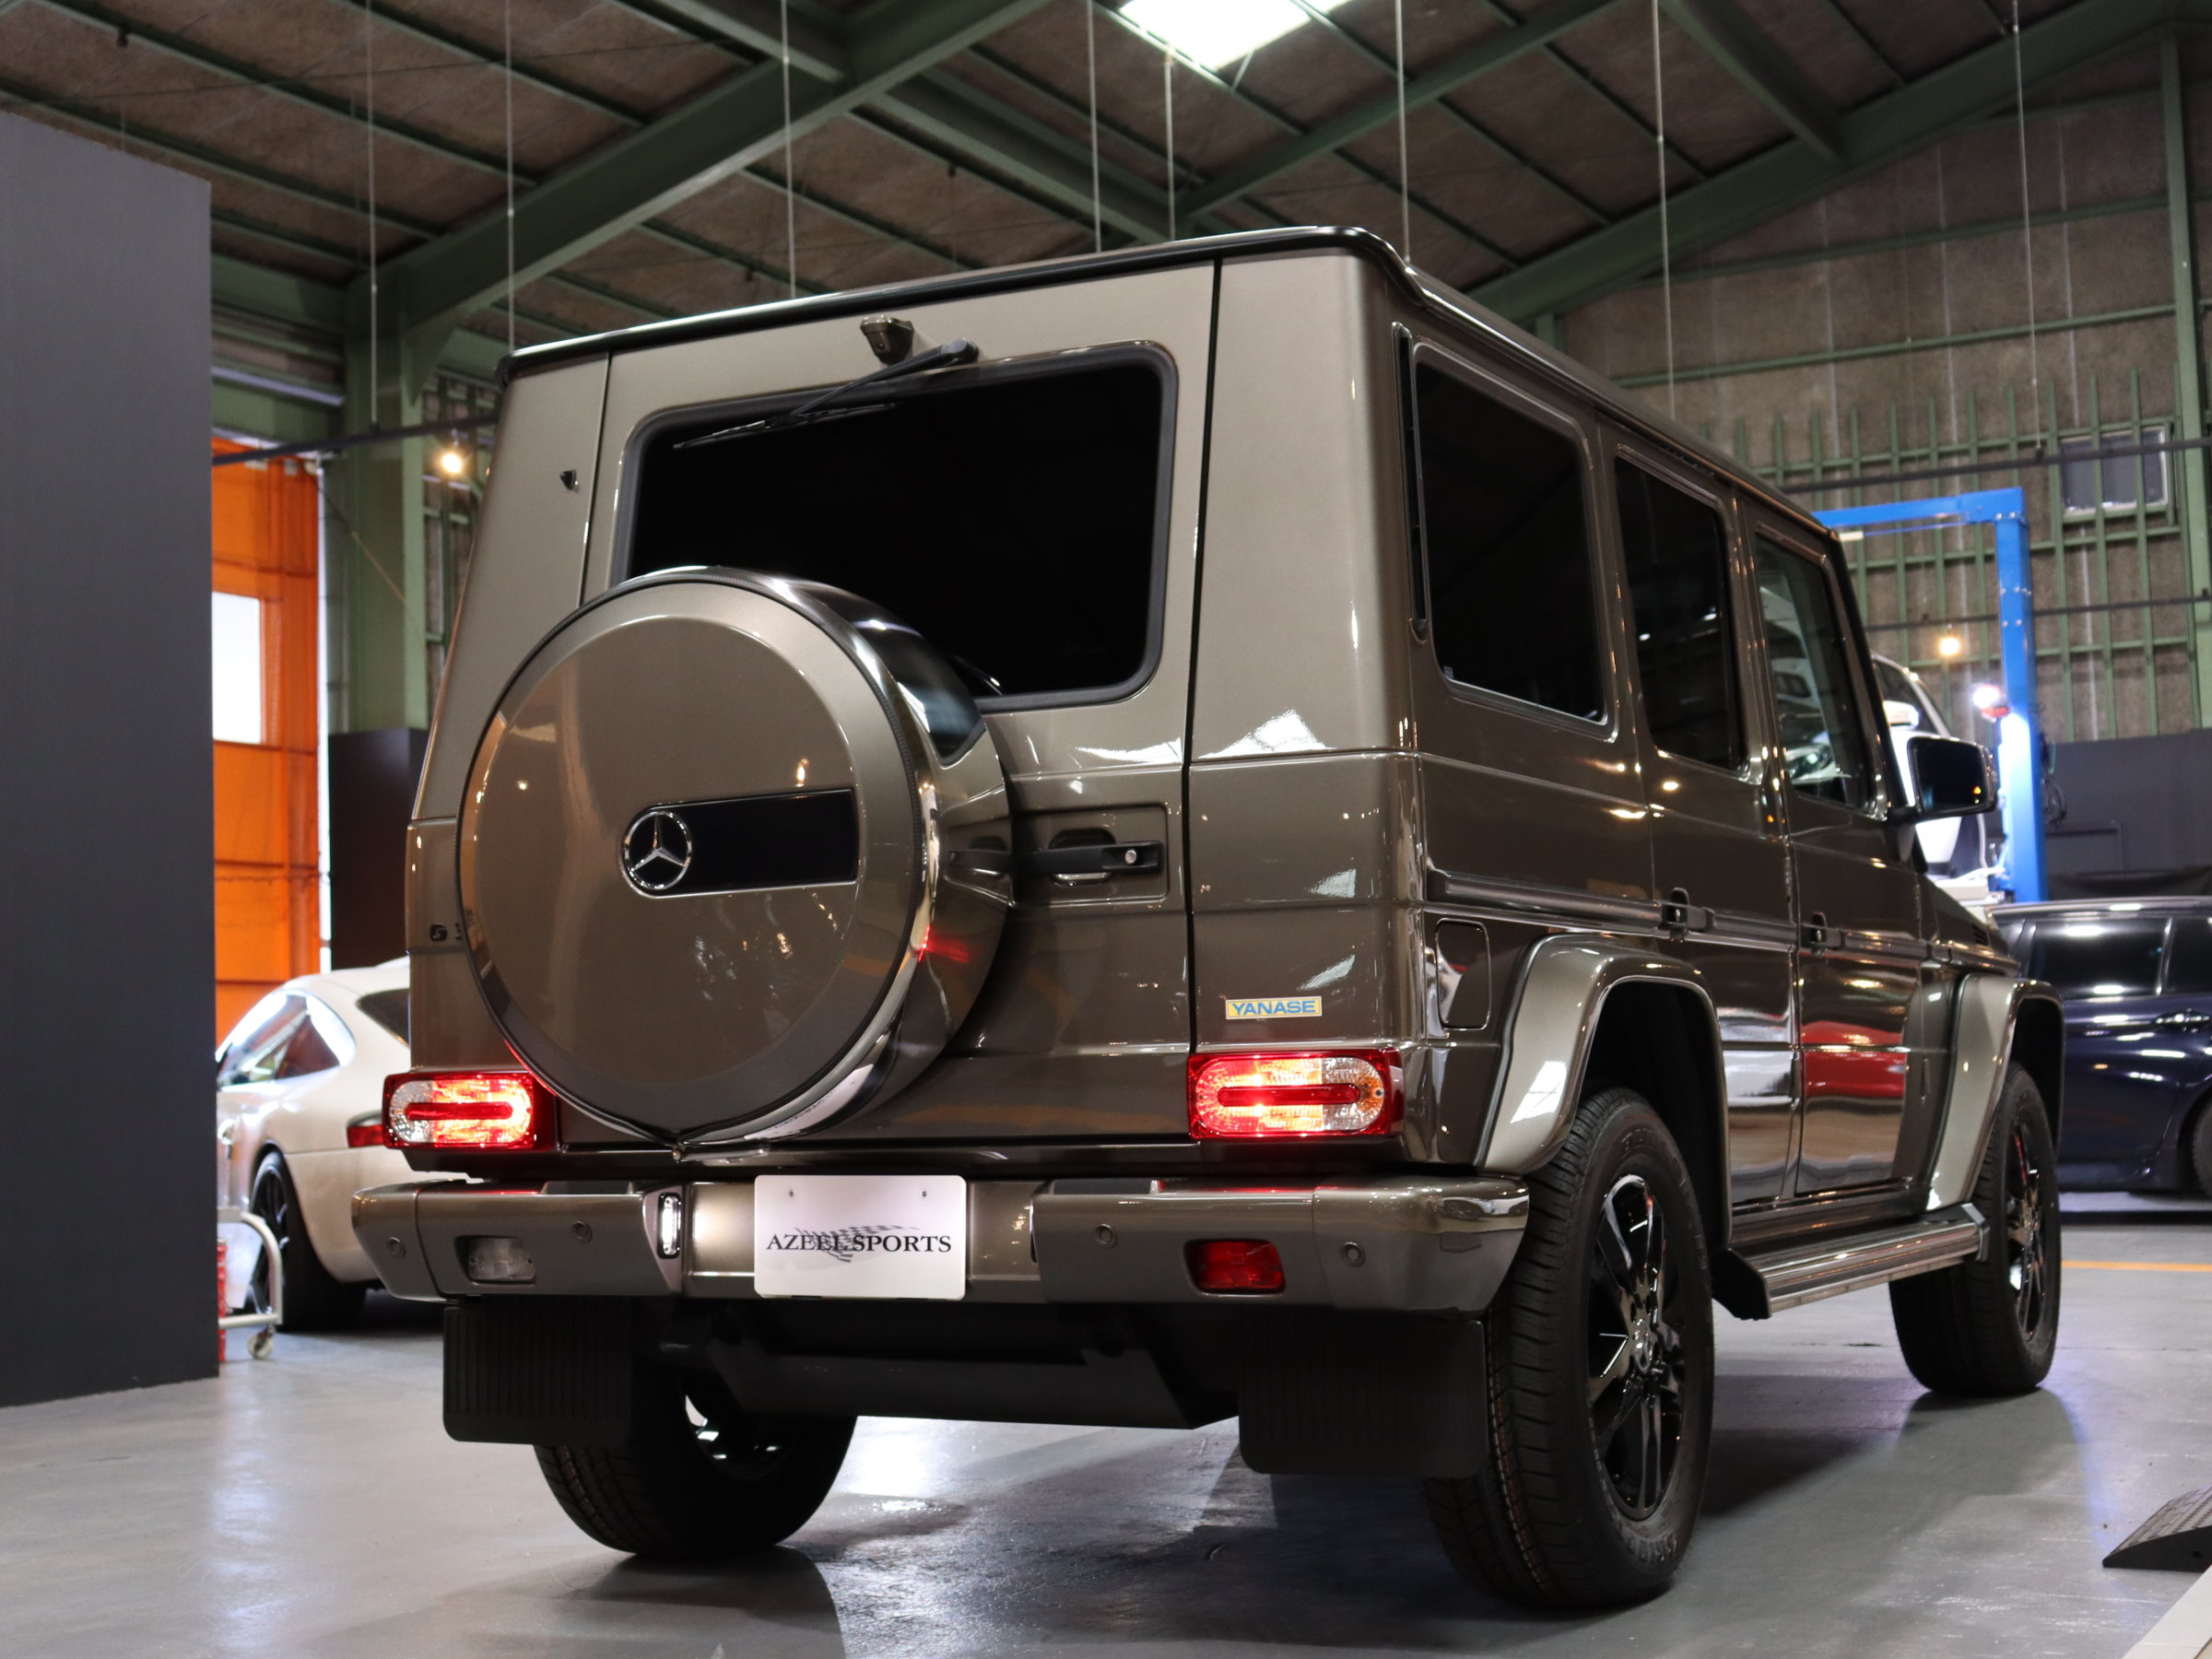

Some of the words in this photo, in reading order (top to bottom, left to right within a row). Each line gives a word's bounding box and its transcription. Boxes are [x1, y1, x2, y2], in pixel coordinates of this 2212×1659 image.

[1231, 1000, 1316, 1016] YANASE
[766, 1233, 851, 1252] AZEEL
[853, 1234, 951, 1253] SPORTS
